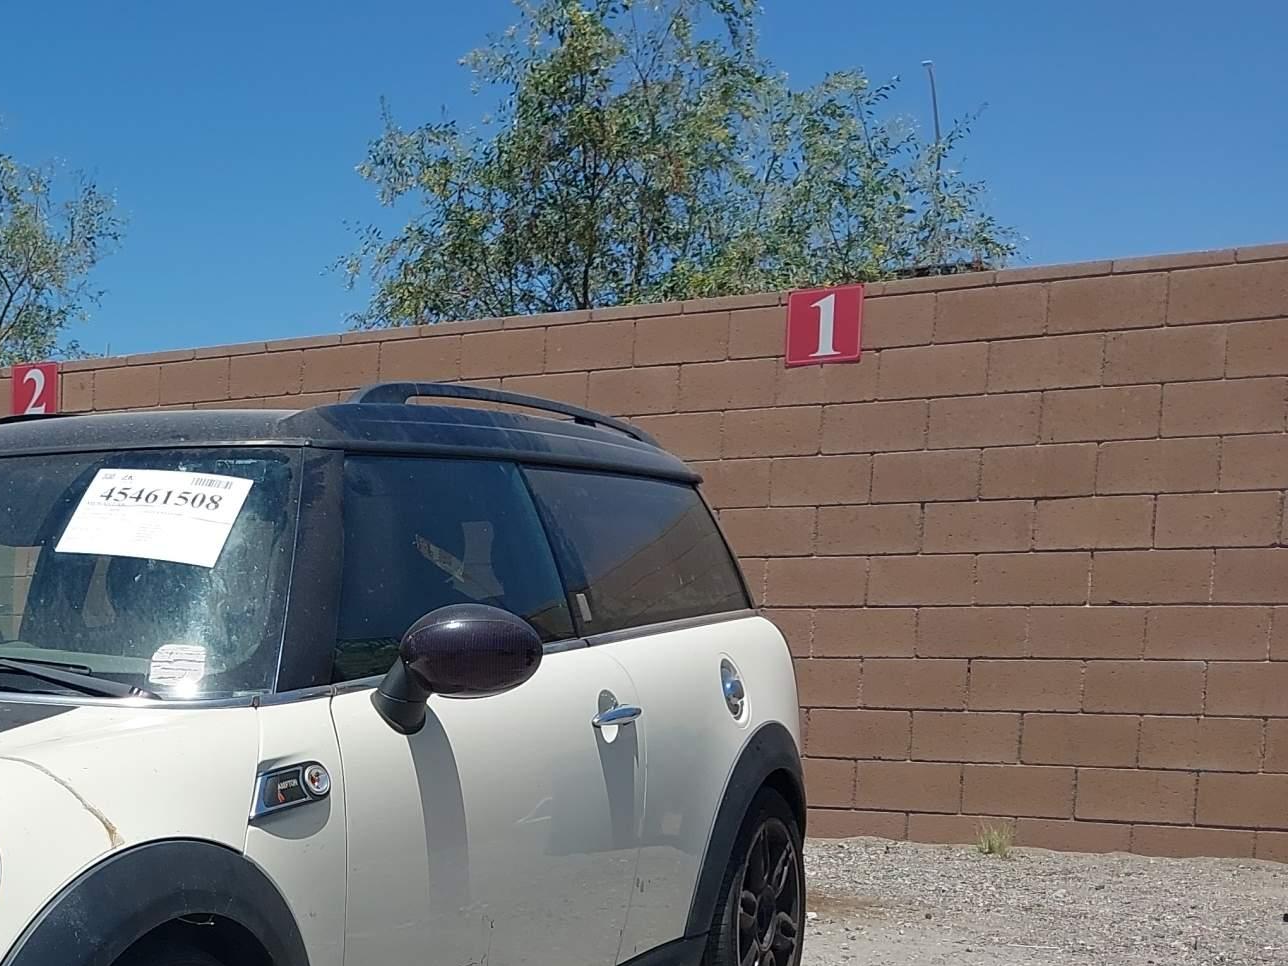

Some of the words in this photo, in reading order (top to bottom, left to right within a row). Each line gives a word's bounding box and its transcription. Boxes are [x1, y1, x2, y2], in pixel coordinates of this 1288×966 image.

[808, 293, 842, 357] 1
[23, 368, 47, 414] 2
[100, 486, 223, 511] 45461508
